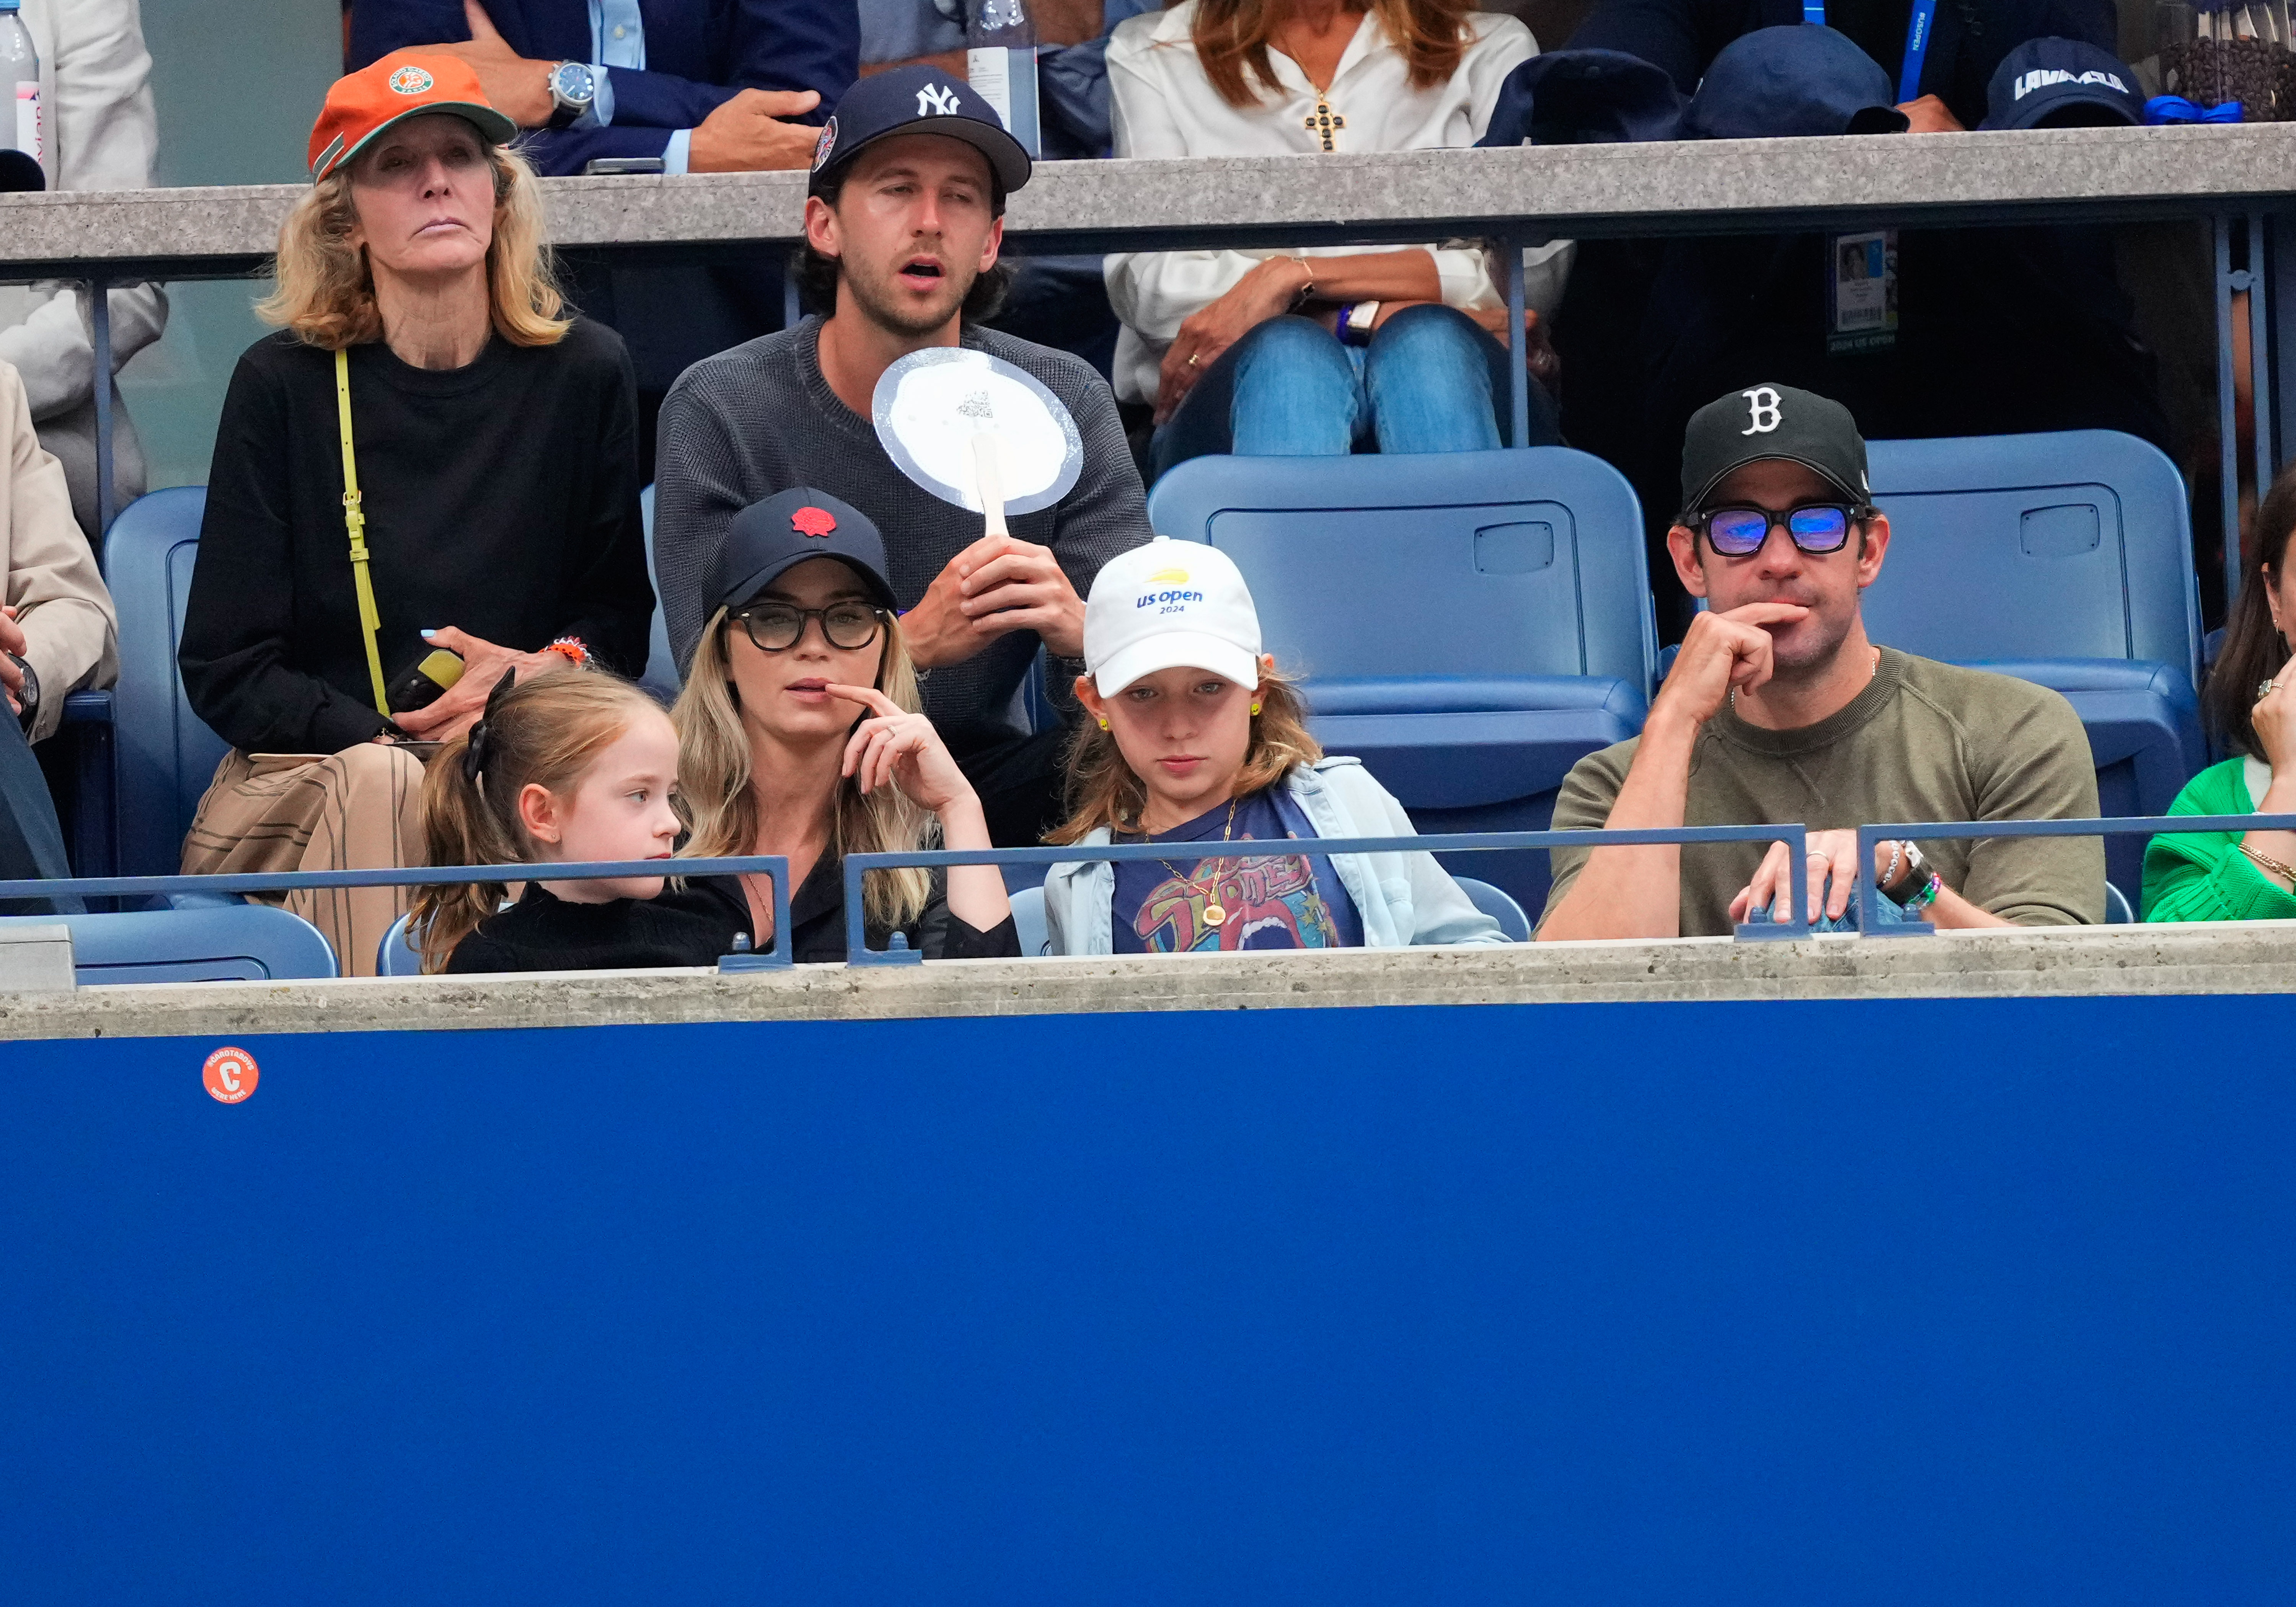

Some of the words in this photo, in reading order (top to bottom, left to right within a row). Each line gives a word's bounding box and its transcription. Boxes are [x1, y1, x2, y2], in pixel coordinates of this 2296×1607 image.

[391, 68, 406, 87] ROLAND
[408, 67, 431, 82] GARROS
[916, 83, 961, 116] NY
[1742, 387, 1782, 435] B
[1159, 591, 1203, 605] open
[1159, 605, 1185, 614] 2024
[219, 1061, 241, 1091] C
[229, 1089, 246, 1100] HERE
